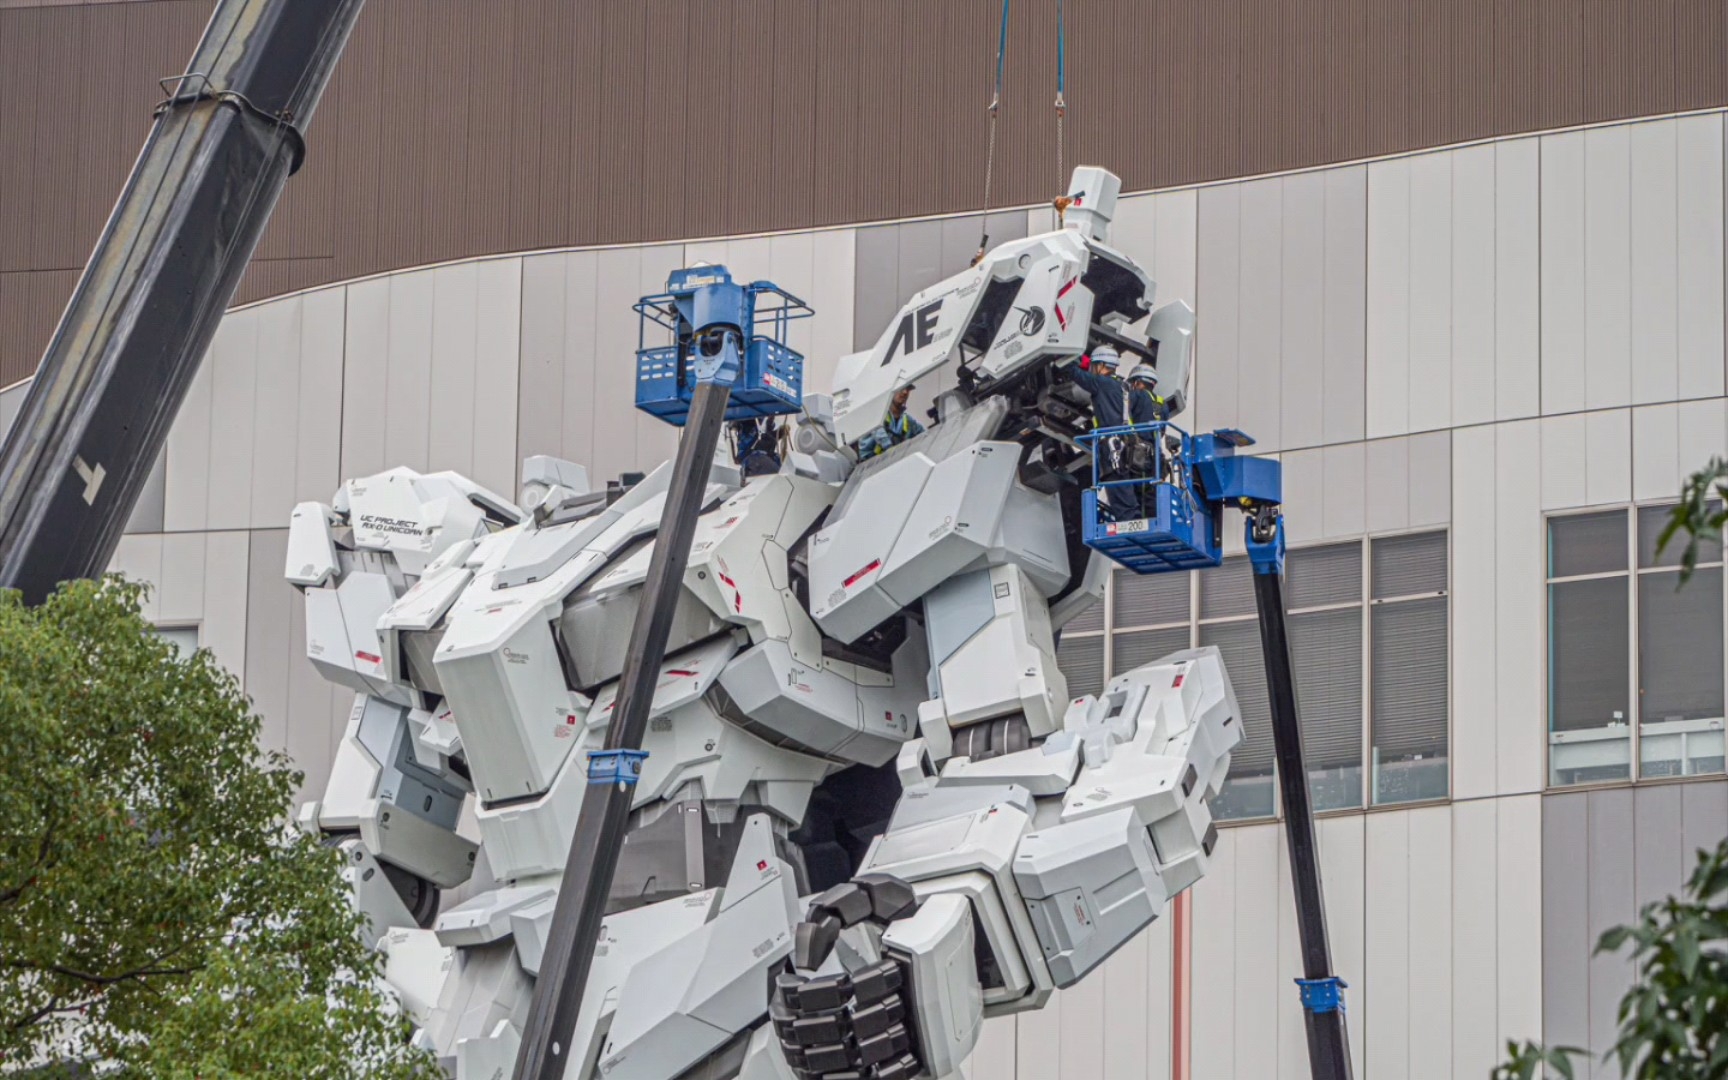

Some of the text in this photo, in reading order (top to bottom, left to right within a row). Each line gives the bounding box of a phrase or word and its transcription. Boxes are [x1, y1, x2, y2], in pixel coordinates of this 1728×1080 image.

[360, 514, 418, 528] UC PROJECT
[1128, 521, 1143, 531] 200
[383, 525, 423, 536] UNICORN
